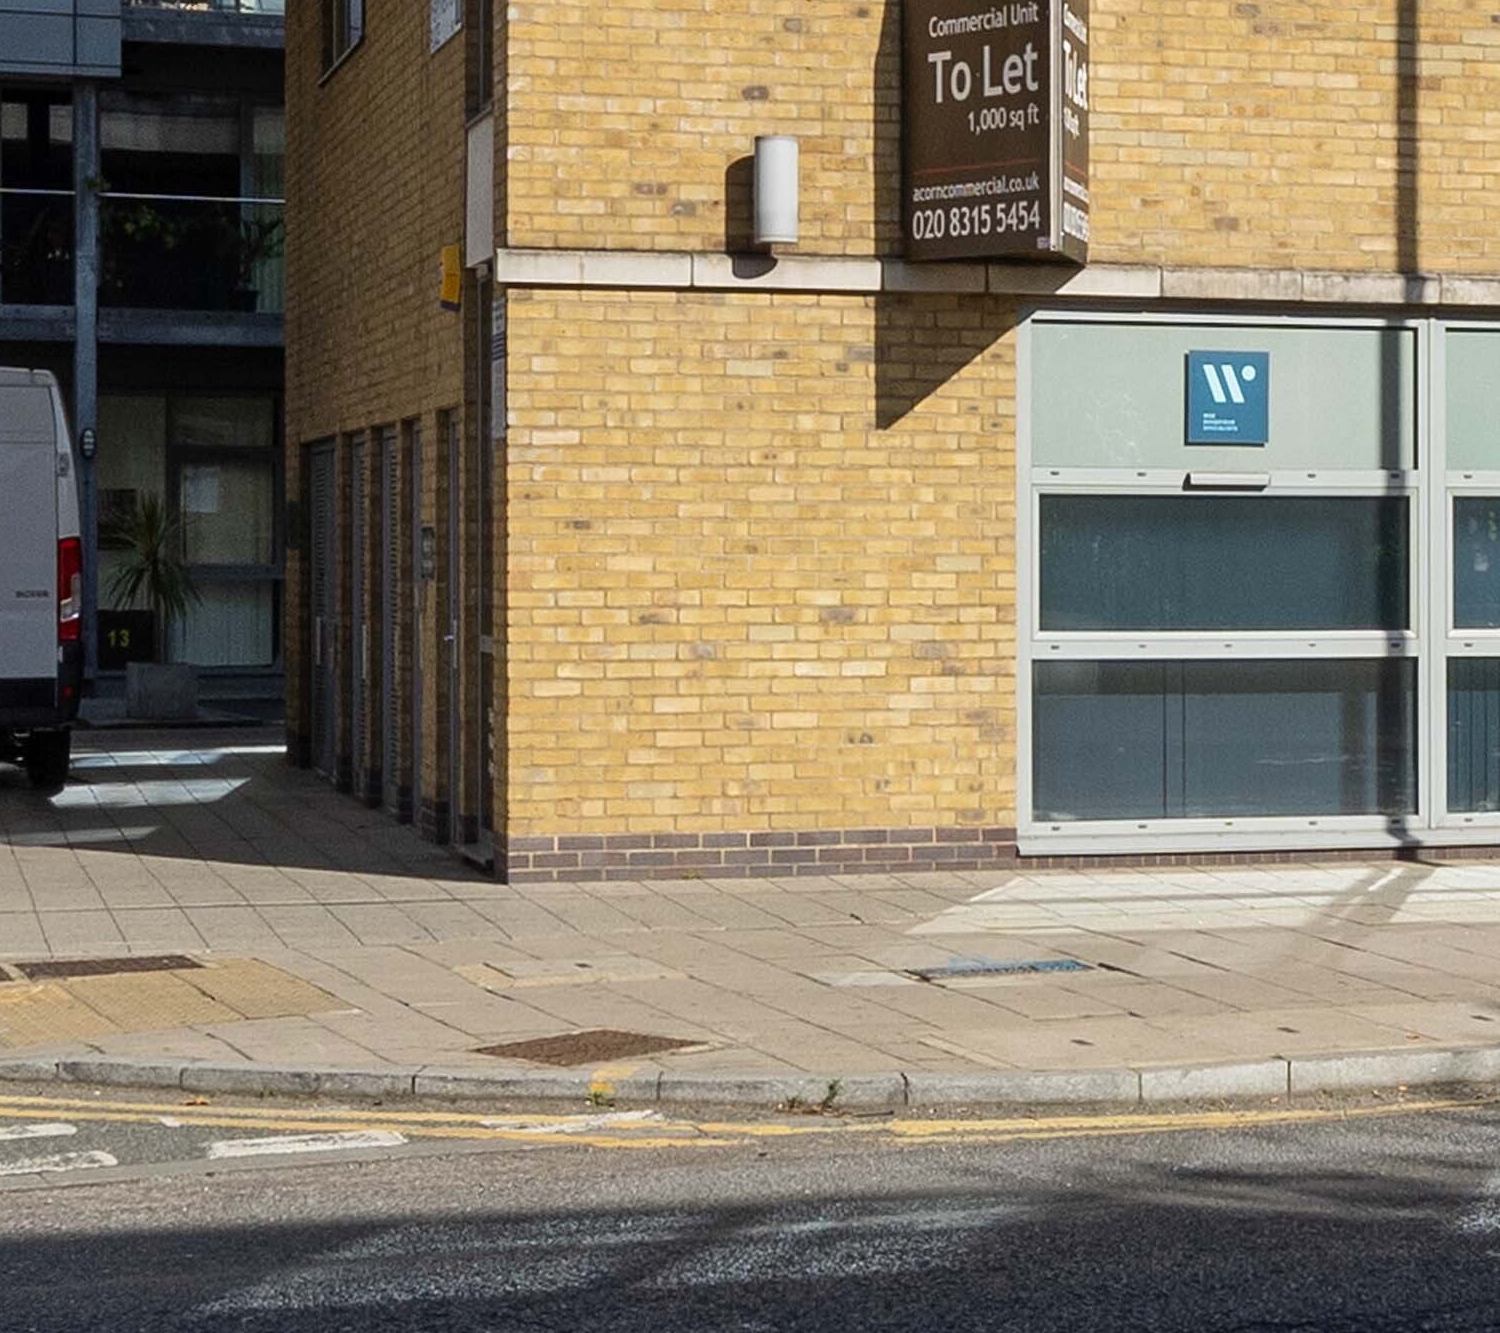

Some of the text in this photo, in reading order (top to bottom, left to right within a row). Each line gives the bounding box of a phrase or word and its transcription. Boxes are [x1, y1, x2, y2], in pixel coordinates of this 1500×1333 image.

[929, 5, 1008, 38] Commercial
[1010, 1, 1039, 26] Unit
[927, 51, 972, 103] To
[983, 42, 1039, 97] Let
[968, 107, 1007, 135] 1,000
[1009, 109, 1025, 131] sq
[1027, 102, 1039, 125] ft
[912, 171, 1040, 202] acorncommercial.co.uk
[912, 209, 945, 240] 020
[950, 205, 991, 237] 8315
[995, 200, 1040, 233] 5454
[108, 629, 130, 647] 13
